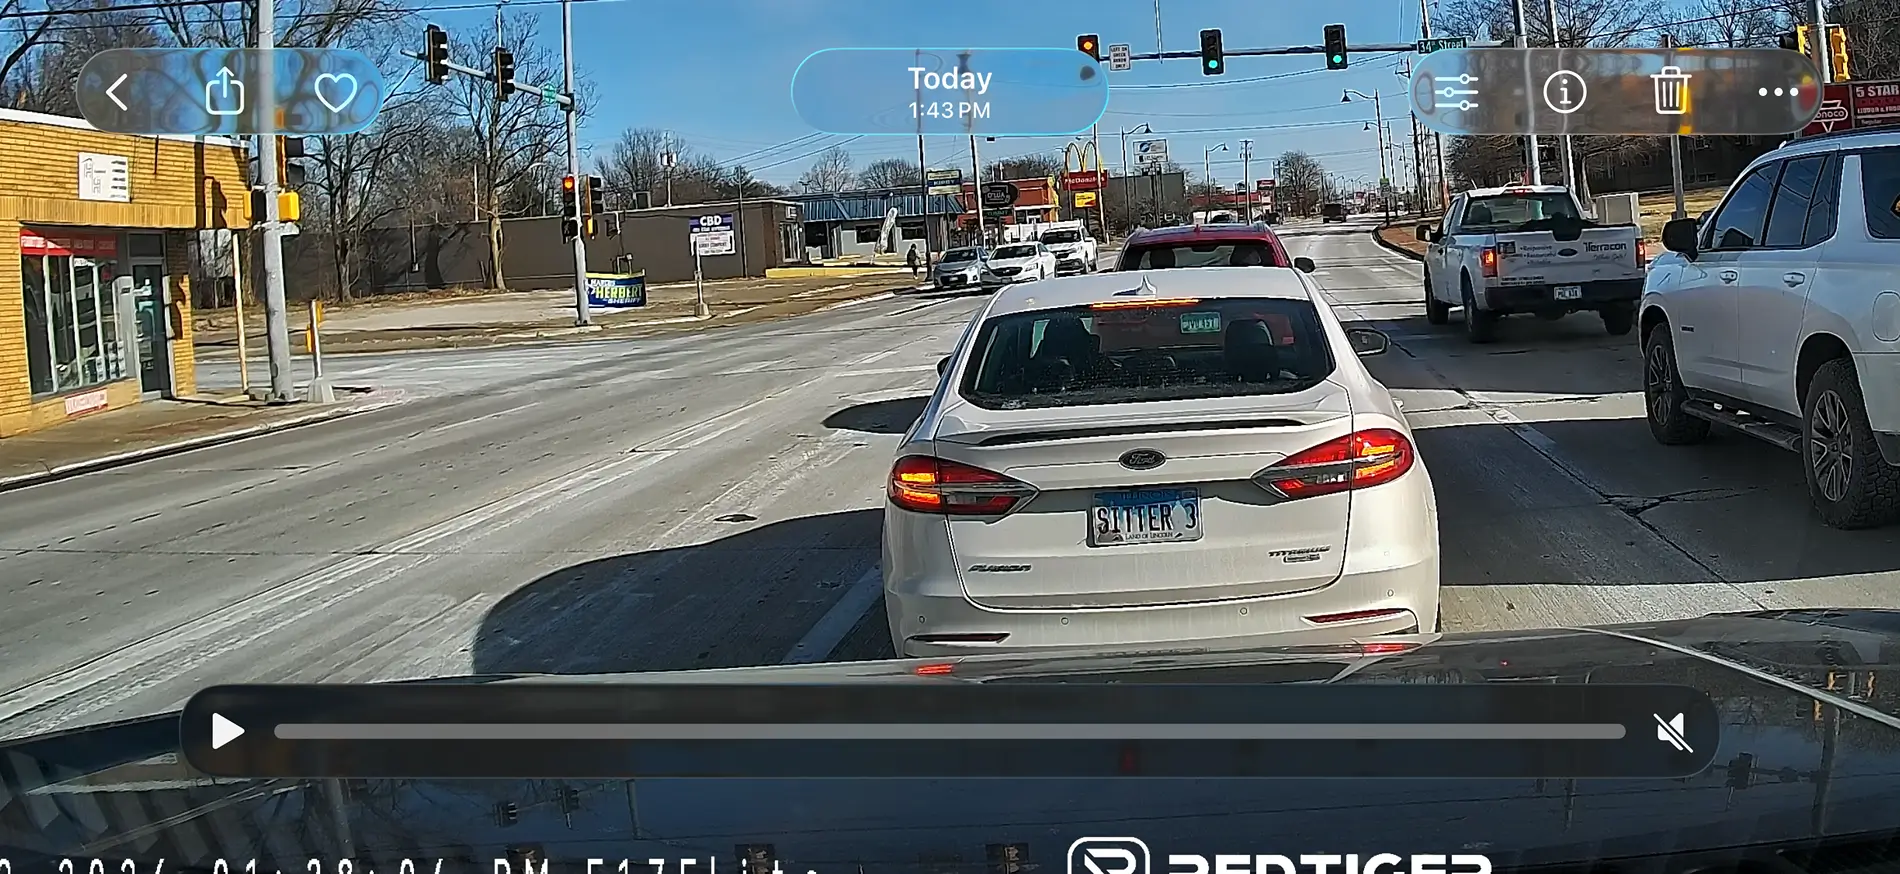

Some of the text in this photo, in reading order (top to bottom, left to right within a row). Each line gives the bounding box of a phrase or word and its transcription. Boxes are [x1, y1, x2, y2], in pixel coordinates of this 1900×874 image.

[1438, 39, 1464, 50] Street
[1856, 84, 1900, 98] 5 STAR
[699, 215, 722, 226] CBD
[1583, 242, 1627, 252] Terracon
[595, 284, 643, 299] HERBERT
[1129, 453, 1156, 465] Ford
[1096, 502, 1197, 534] SITTER 3
[1125, 532, 1142, 541] LAND
